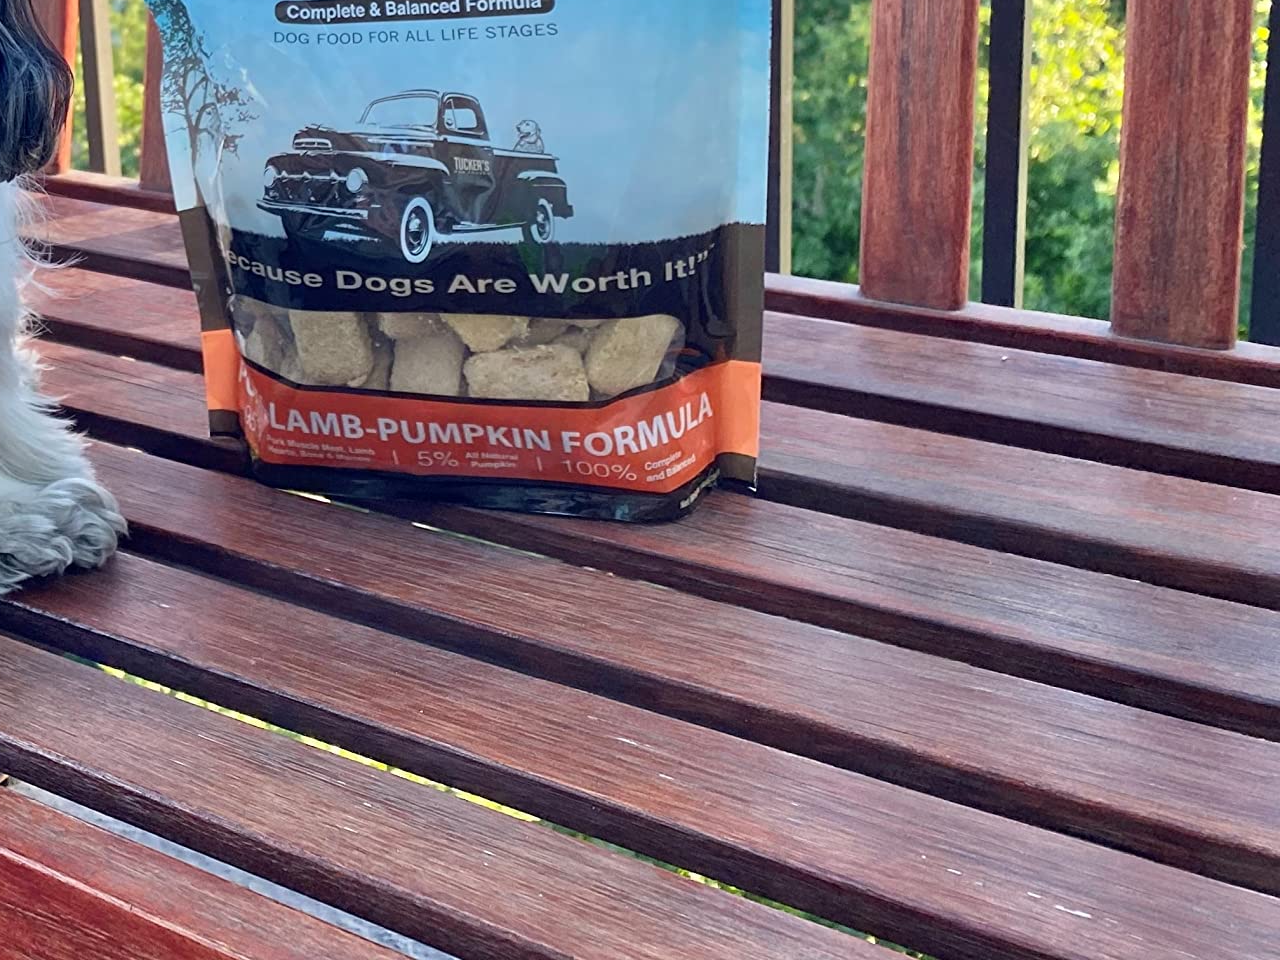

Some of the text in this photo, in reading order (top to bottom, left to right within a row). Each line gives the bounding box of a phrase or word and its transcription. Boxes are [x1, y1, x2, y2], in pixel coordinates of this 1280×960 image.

[286, 0, 365, 22] Complete
[369, 0, 381, 17] &
[274, 23, 558, 45] DOG FOOD FOR ALL LIFE STAGES
[453, 156, 491, 172] TUCKER'S
[225, 248, 323, 288] ecause
[335, 270, 435, 297] Dogs
[448, 274, 517, 294] Are
[528, 268, 652, 294] Worth
[561, 392, 713, 457] FORMULA
[417, 450, 459, 467] 5%
[465, 452, 519, 462] All Natural
[471, 461, 517, 470] Pumpkin
[644, 451, 682, 471] Complete
[646, 453, 697, 482] and Balanced
[561, 460, 637, 481] 100%
